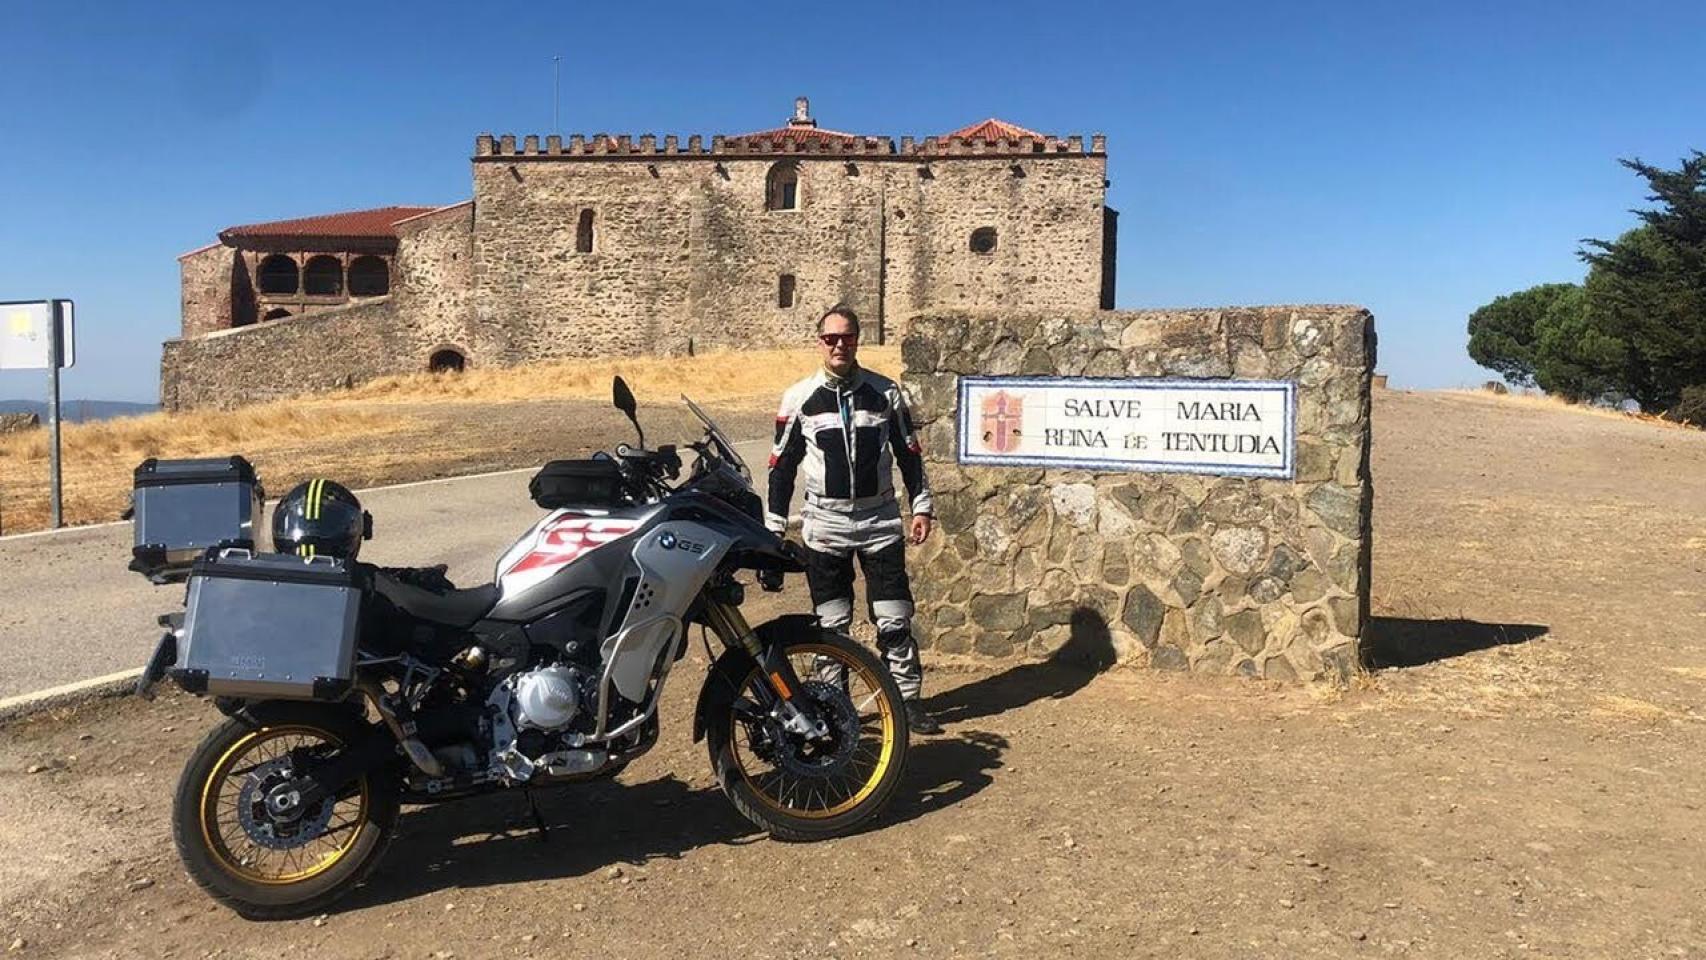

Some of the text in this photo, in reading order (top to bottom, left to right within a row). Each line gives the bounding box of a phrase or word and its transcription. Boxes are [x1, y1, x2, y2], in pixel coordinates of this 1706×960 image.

[1064, 398, 1261, 421] SALVE MARIA
[1045, 428, 1108, 448] REINA
[1161, 431, 1281, 454] TENTUDIA
[678, 539, 705, 554] GS
